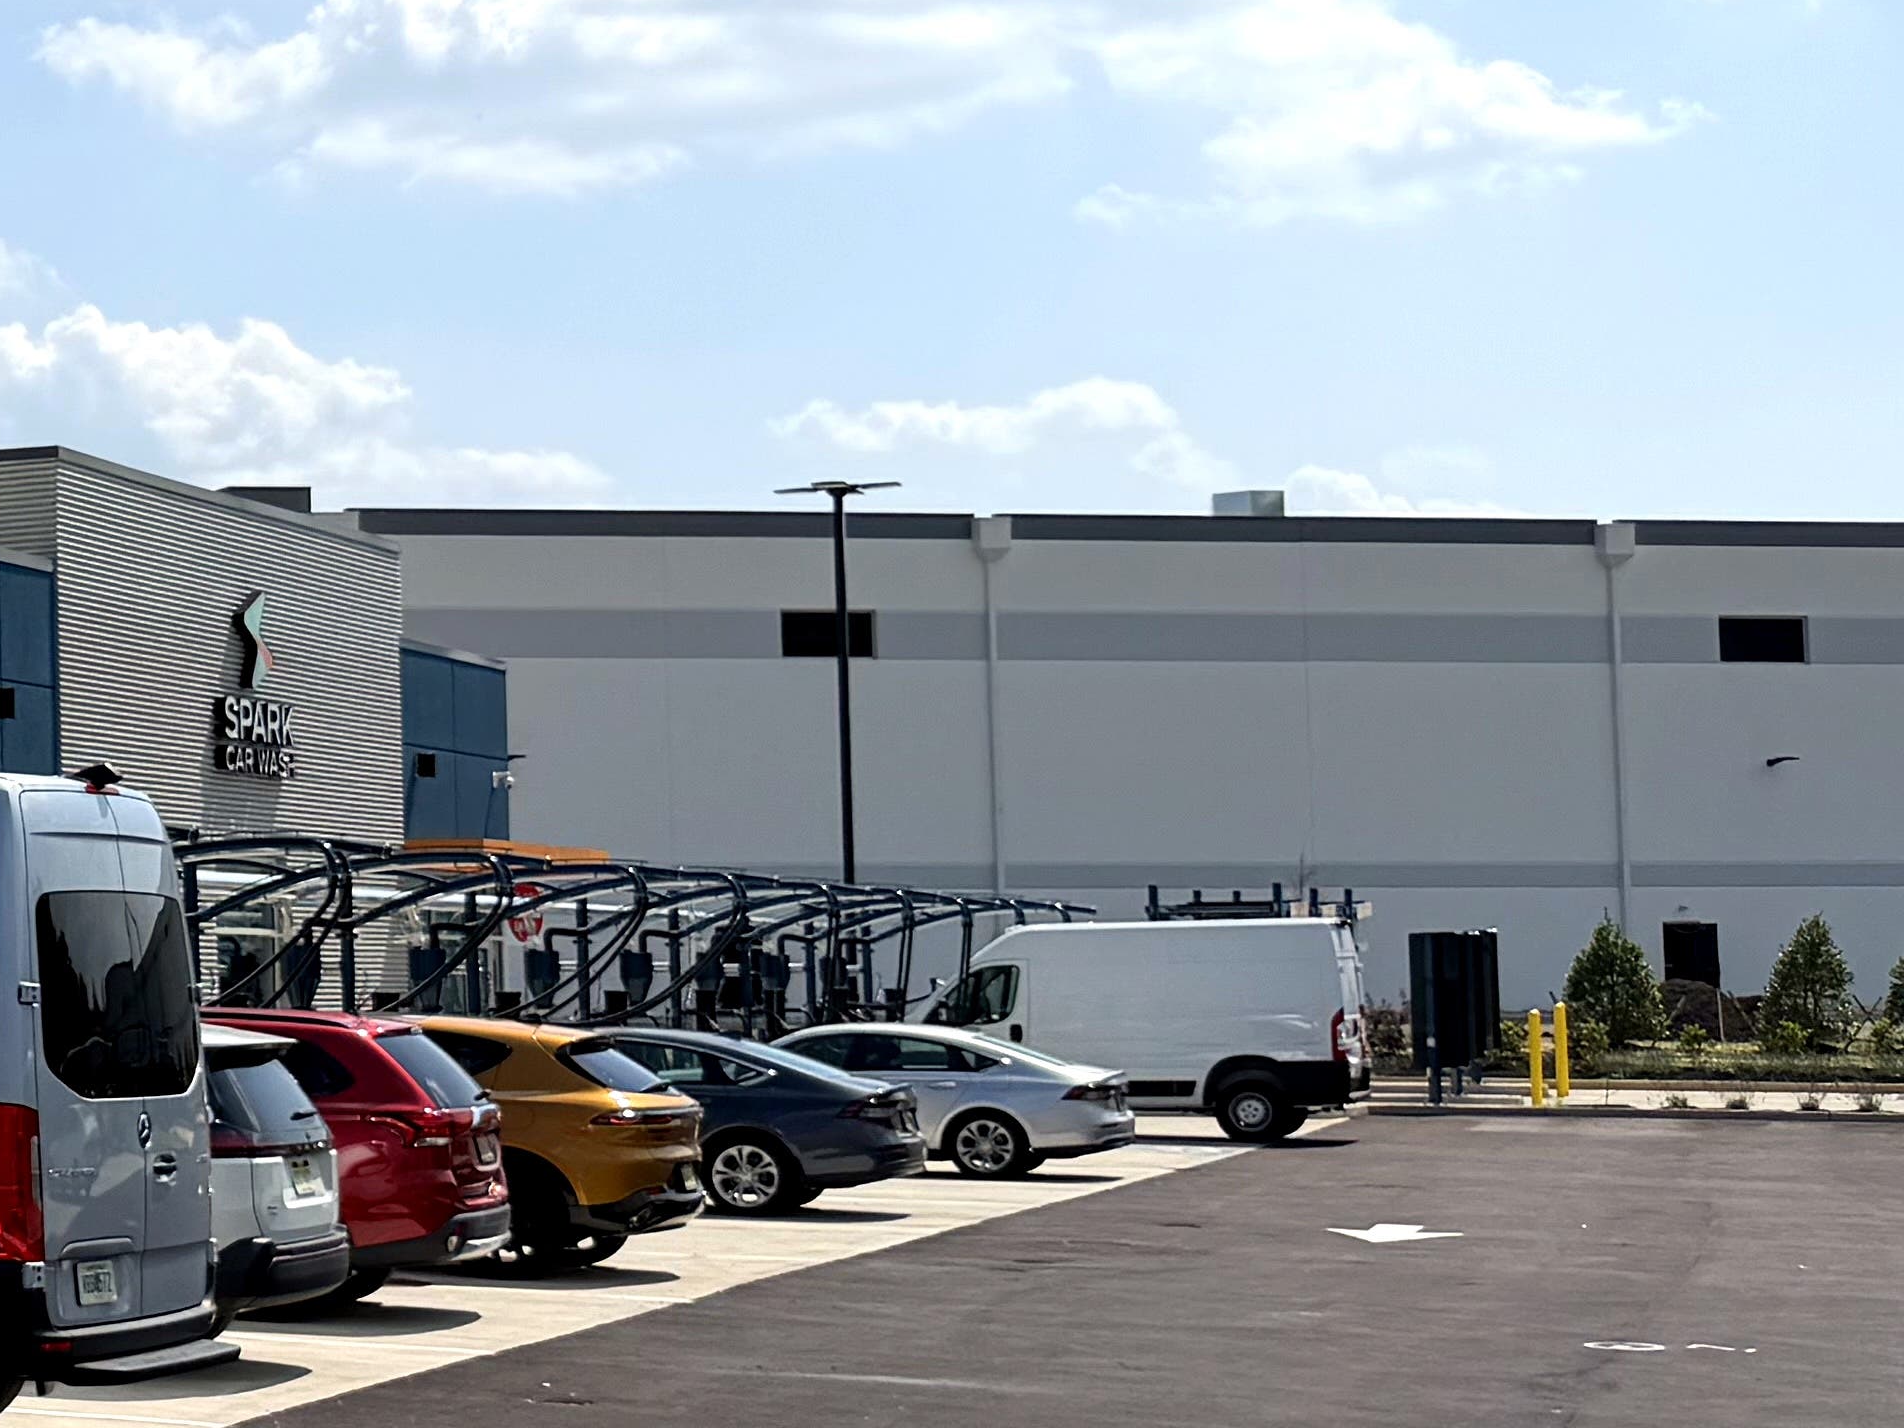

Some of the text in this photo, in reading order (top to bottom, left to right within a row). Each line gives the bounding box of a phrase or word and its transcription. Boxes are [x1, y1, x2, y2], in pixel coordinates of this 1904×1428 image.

[225, 695, 294, 746] SPARK
[226, 745, 296, 778] CAR WASH
